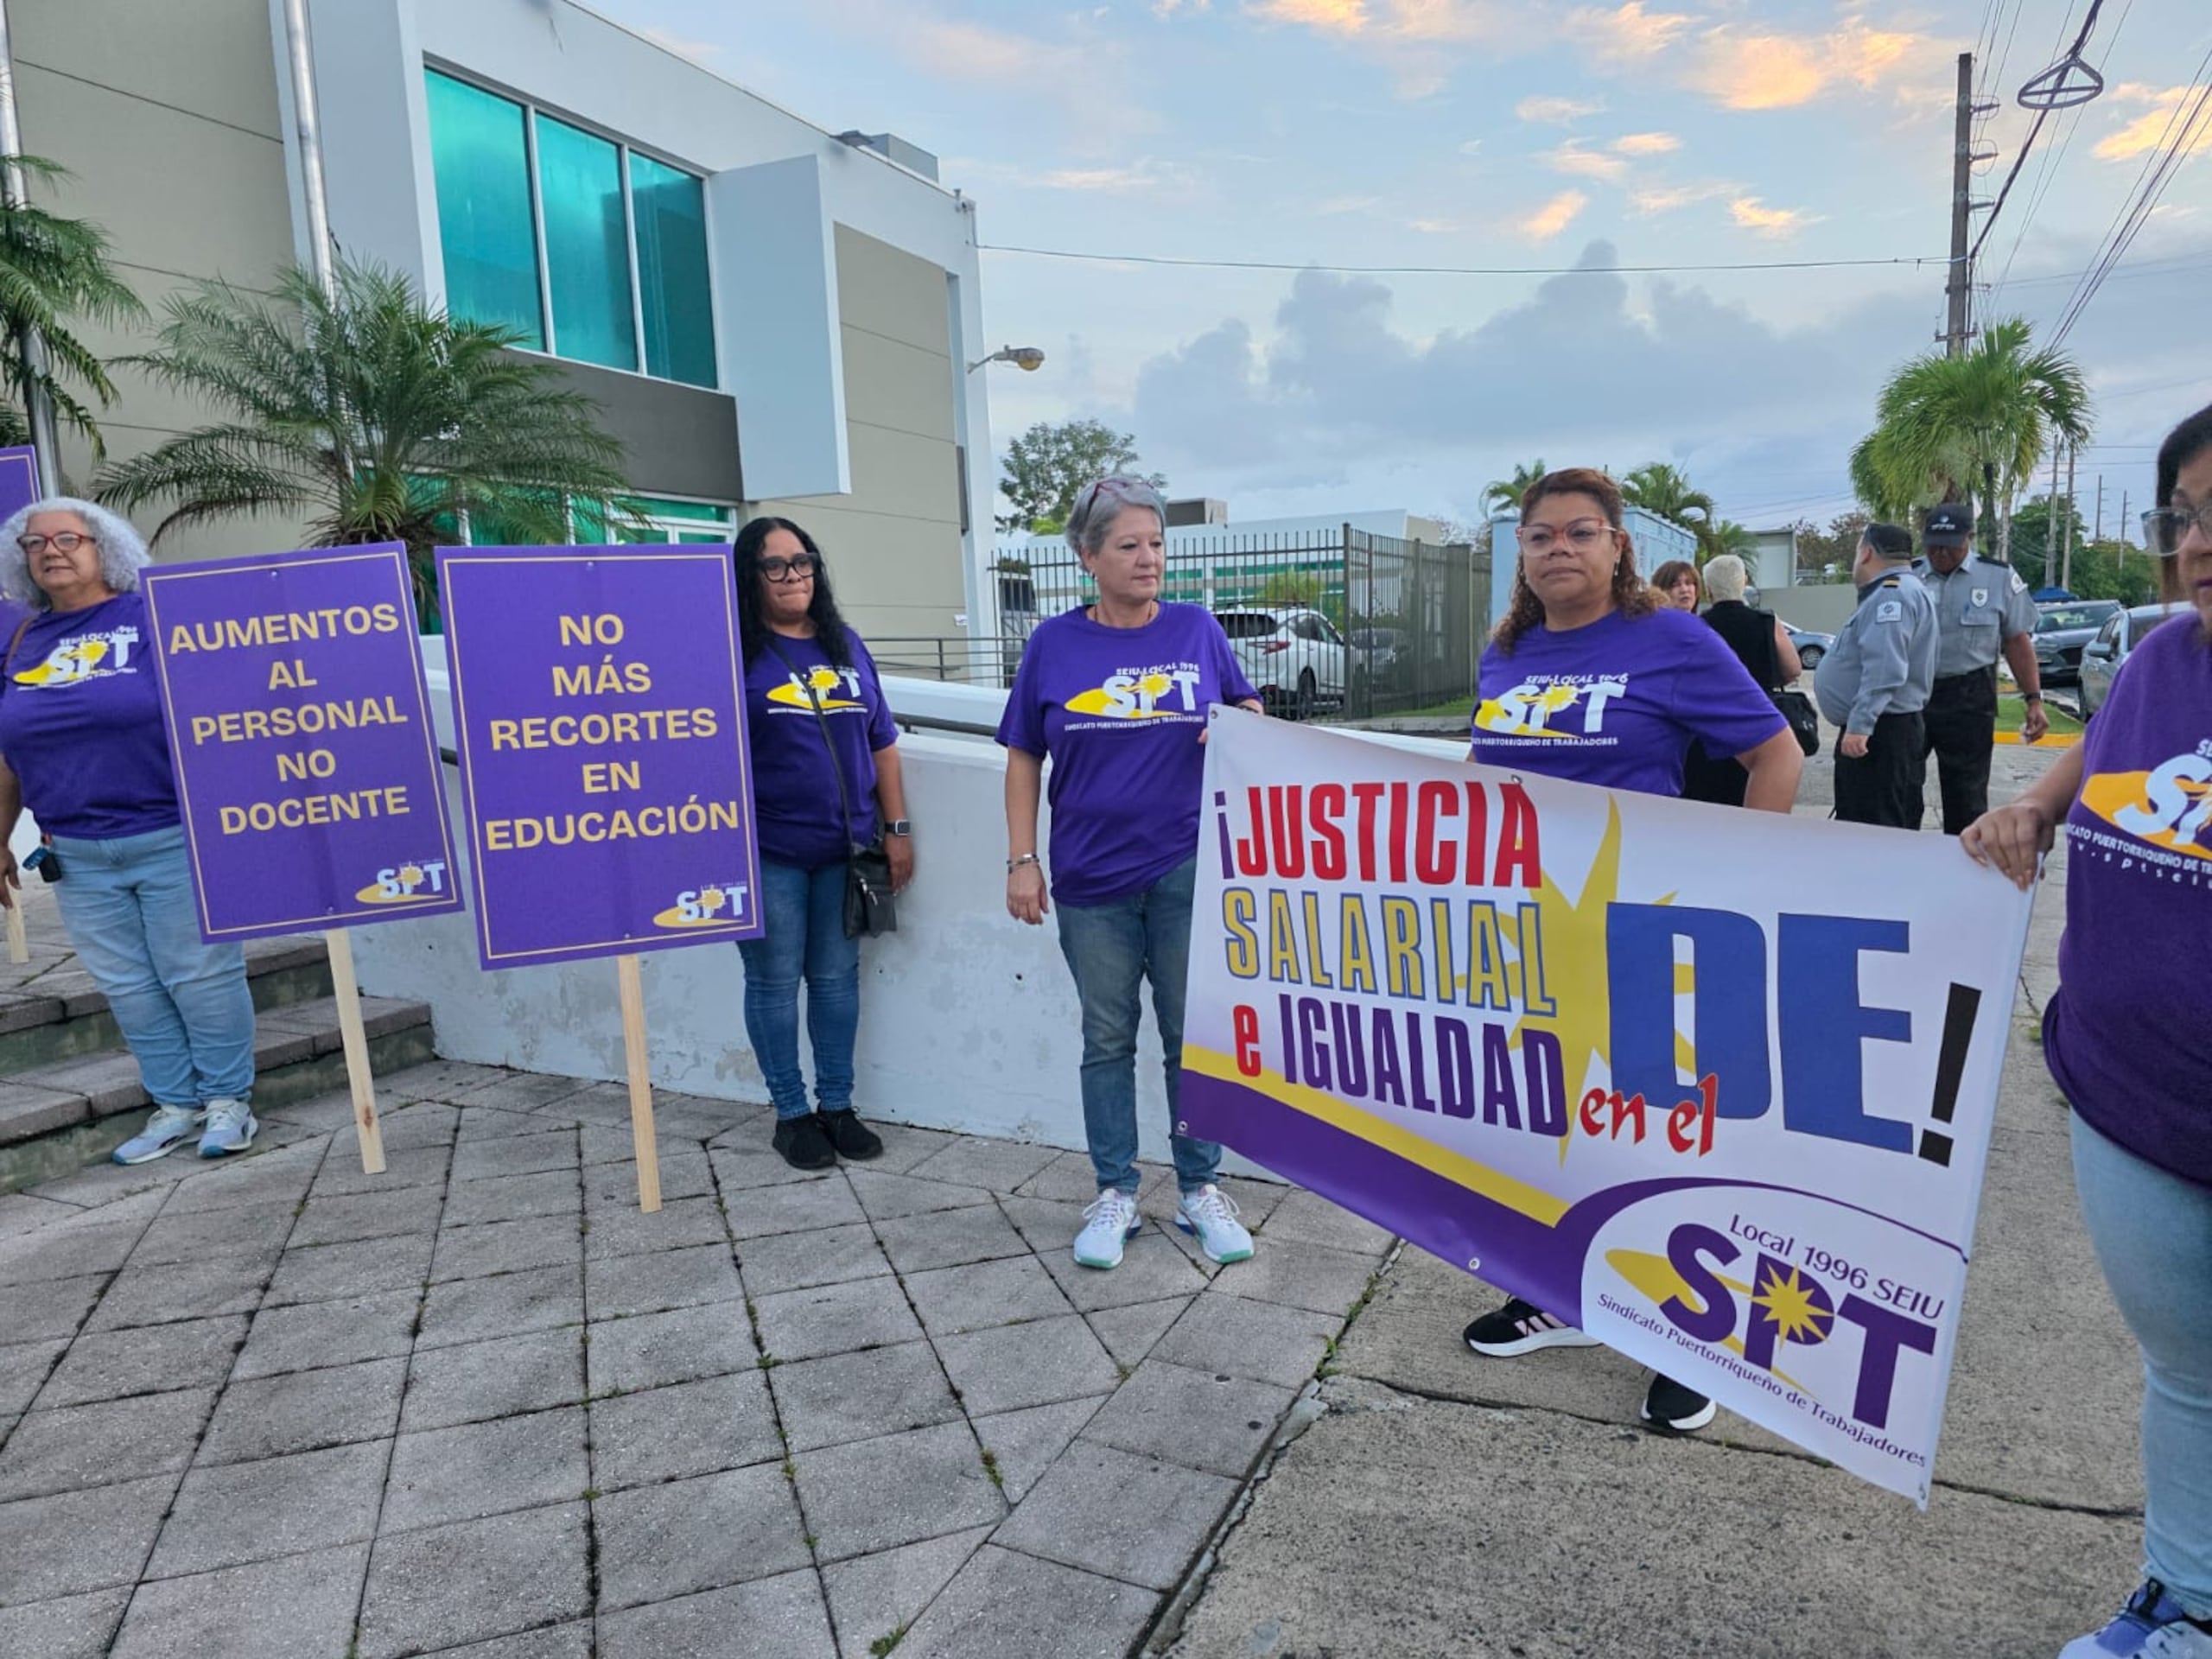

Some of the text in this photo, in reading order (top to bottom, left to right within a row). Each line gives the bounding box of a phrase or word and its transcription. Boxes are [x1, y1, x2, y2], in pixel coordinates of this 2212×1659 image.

[169, 603, 398, 654] AUMENTOS
[559, 613, 624, 646] NO
[48, 632, 139, 683] SPT
[268, 659, 317, 690] AL
[551, 655, 652, 696] MÁS
[1102, 670, 1200, 718] SPT
[1489, 681, 1626, 733] SPT
[191, 696, 408, 745] PERSONAL
[490, 708, 718, 751] RECORTES
[276, 748, 336, 782] NO
[582, 761, 640, 793] EN
[219, 786, 410, 836] DOCENTE
[485, 795, 739, 850] EDUCACIÓN
[1215, 781, 1542, 888] ¡JUSTICIA
[377, 862, 446, 899] SPT
[677, 885, 747, 923] SPT
[1222, 887, 1558, 1018] SALARIAL
[1233, 994, 1568, 1137] e IGUALDAD
[1580, 1086, 1646, 1145] en
[1667, 1072, 1719, 1157] el
[1729, 1213, 1945, 1320] Local 1996 SEIU
[1658, 1223, 1937, 1430] SPT
[1597, 1293, 1926, 1468] Sindicato Puertorriqueño de Trabajadores
